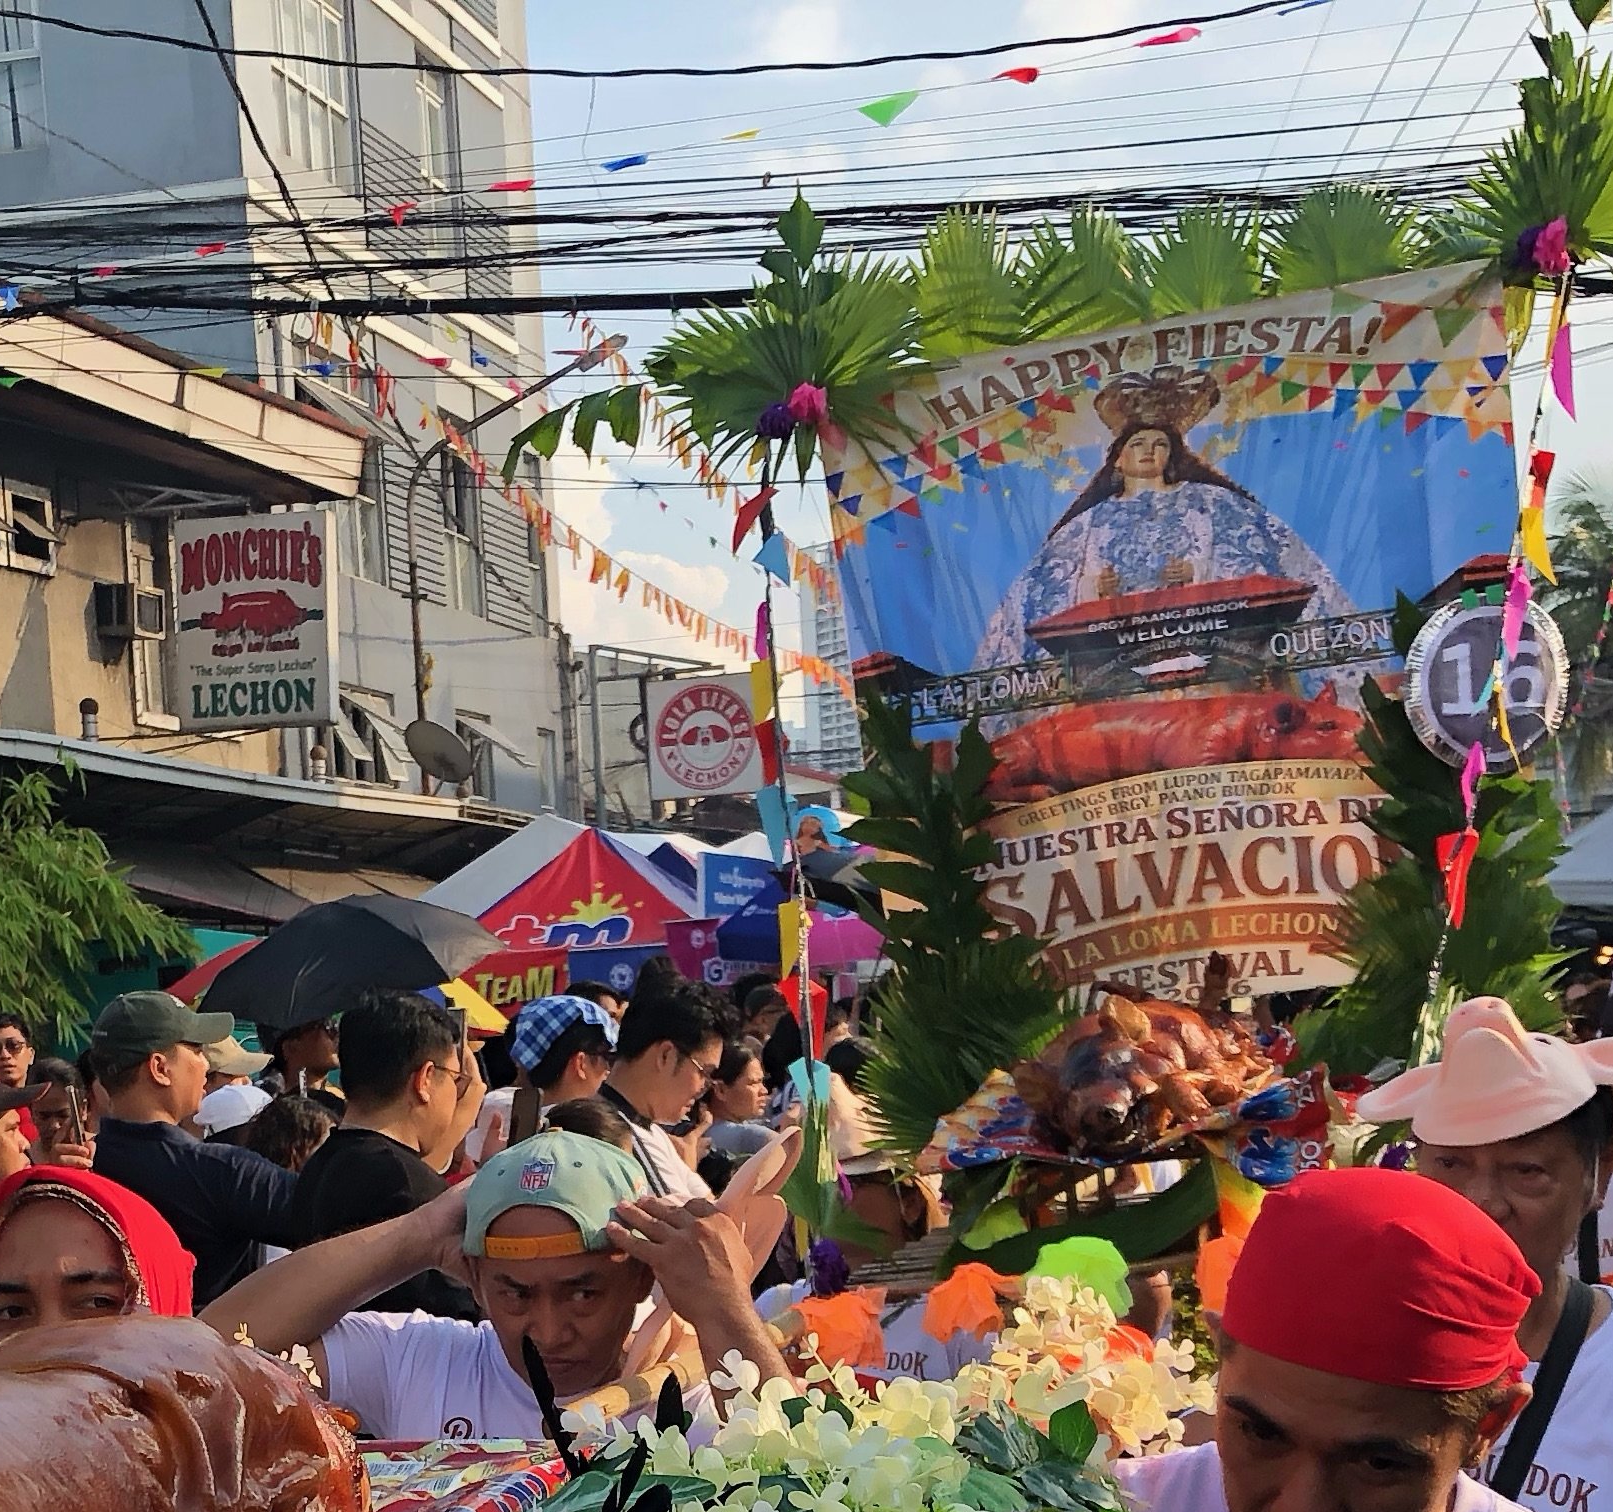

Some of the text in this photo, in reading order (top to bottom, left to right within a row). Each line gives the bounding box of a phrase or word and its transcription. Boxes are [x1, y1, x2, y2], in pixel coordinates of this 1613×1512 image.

[929, 315, 1384, 430] HAPPY FIESTA!
[181, 521, 322, 595] MONCHIE'S
[1117, 618, 1229, 645] WELCOME
[1270, 615, 1390, 660] QUEZON
[216, 662, 244, 678] Super
[922, 682, 959, 712] LA
[975, 670, 1051, 704] LOMA
[1439, 637, 1548, 719] 16
[191, 677, 317, 719] LECHON
[661, 691, 749, 740] LOLA LITA'S
[675, 756, 741, 783] LECHON
[1017, 790, 1108, 828] GREETINGS
[1111, 780, 1158, 803] FROM
[1162, 771, 1223, 793] LUPON
[1082, 780, 1297, 821] OF BRGY. PAANG BUNDOK
[975, 817, 1157, 875] NUESTRA
[1165, 799, 1328, 839] SEÑORA
[1062, 911, 1340, 970] LA LOMA LECHON
[1109, 949, 1304, 995] FESTVAL
[522, 1174, 547, 1188] NFL
[886, 1351, 928, 1381] DOK
